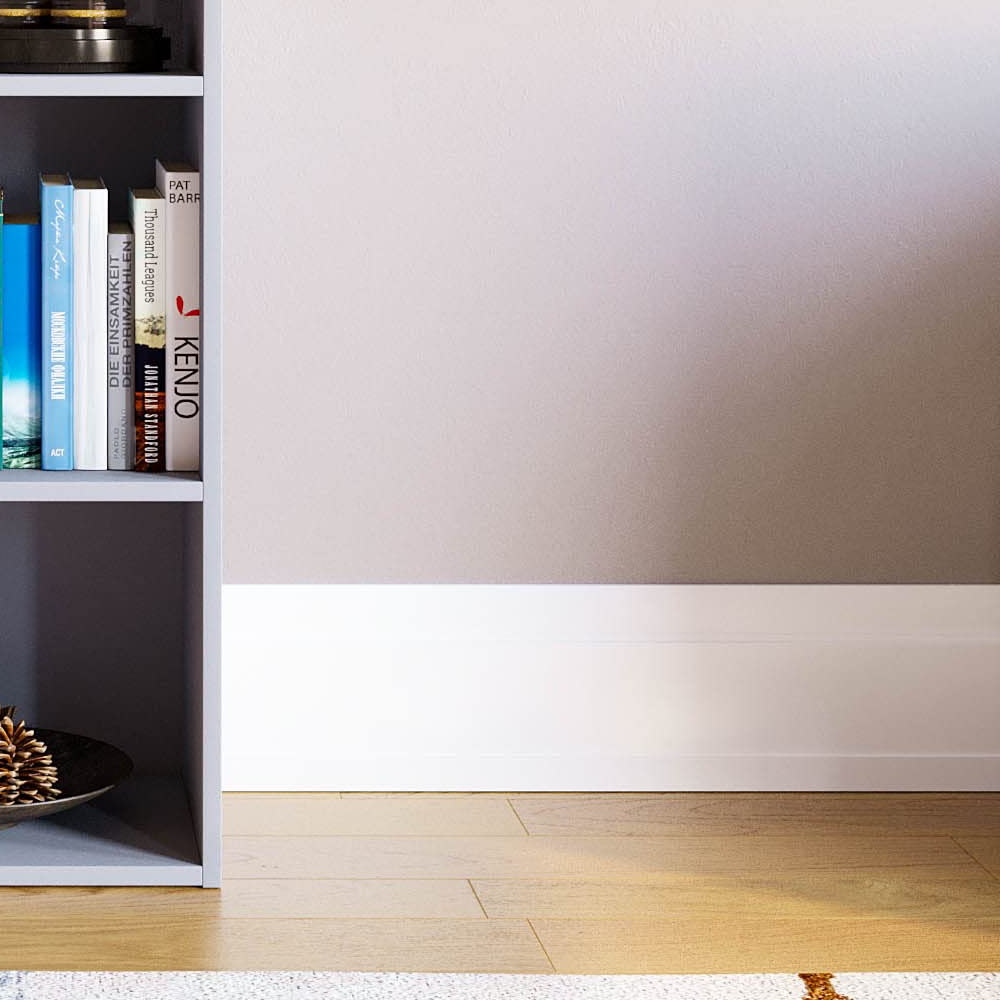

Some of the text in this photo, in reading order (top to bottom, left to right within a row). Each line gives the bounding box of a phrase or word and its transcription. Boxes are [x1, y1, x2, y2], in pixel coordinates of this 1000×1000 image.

[169, 180, 191, 190] PAT
[141, 208, 158, 303] Thousand Leagues
[109, 254, 120, 388] DIE EINSAMKEIT
[122, 240, 133, 388] DER PRIMZAHLEN
[144, 364, 159, 464] JONATHAN STANDFORD
[173, 337, 200, 419] KENJO
